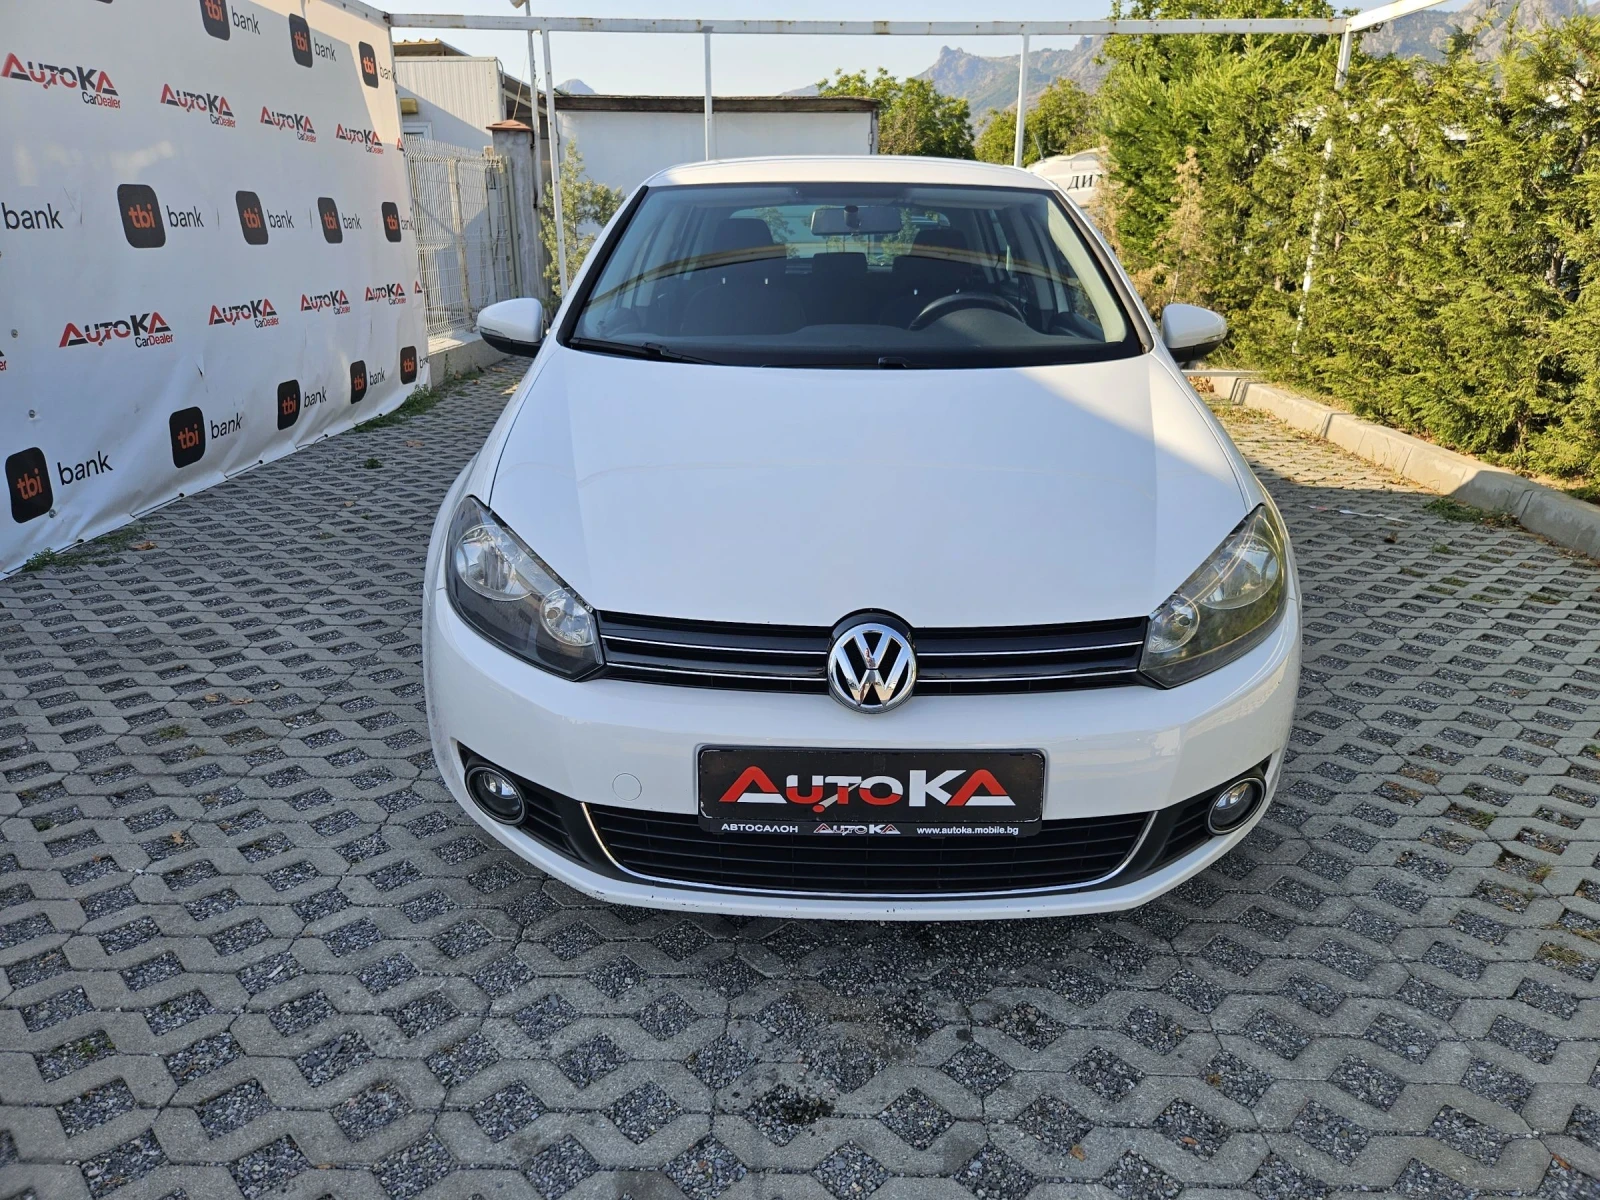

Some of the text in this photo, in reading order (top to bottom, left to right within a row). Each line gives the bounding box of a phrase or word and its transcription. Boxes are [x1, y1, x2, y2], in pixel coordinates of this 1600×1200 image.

[206, 0, 260, 35] tbi bank
[294, 31, 337, 62] tbi bank
[363, 56, 375, 75] tbi
[82, 91, 120, 109] CarDealer
[210, 114, 236, 128] CarDealer
[1067, 174, 1098, 191] ДИ
[1, 202, 64, 230] bank
[128, 203, 205, 228] tbi bank
[243, 207, 294, 229] tbi bank
[323, 211, 362, 230] tbi bank
[386, 214, 399, 230] tbi
[254, 317, 279, 328] CarDealer
[135, 333, 173, 348] CarDealer
[403, 356, 415, 373] tbi
[354, 367, 385, 391] tbi bank
[281, 386, 327, 415] tbi bank
[177, 413, 243, 450] tbi bank
[16, 450, 113, 500] tbi bank
[721, 823, 799, 834] АВТОСАЛОН
[917, 824, 1019, 836] www.autoka.mobile.bg
